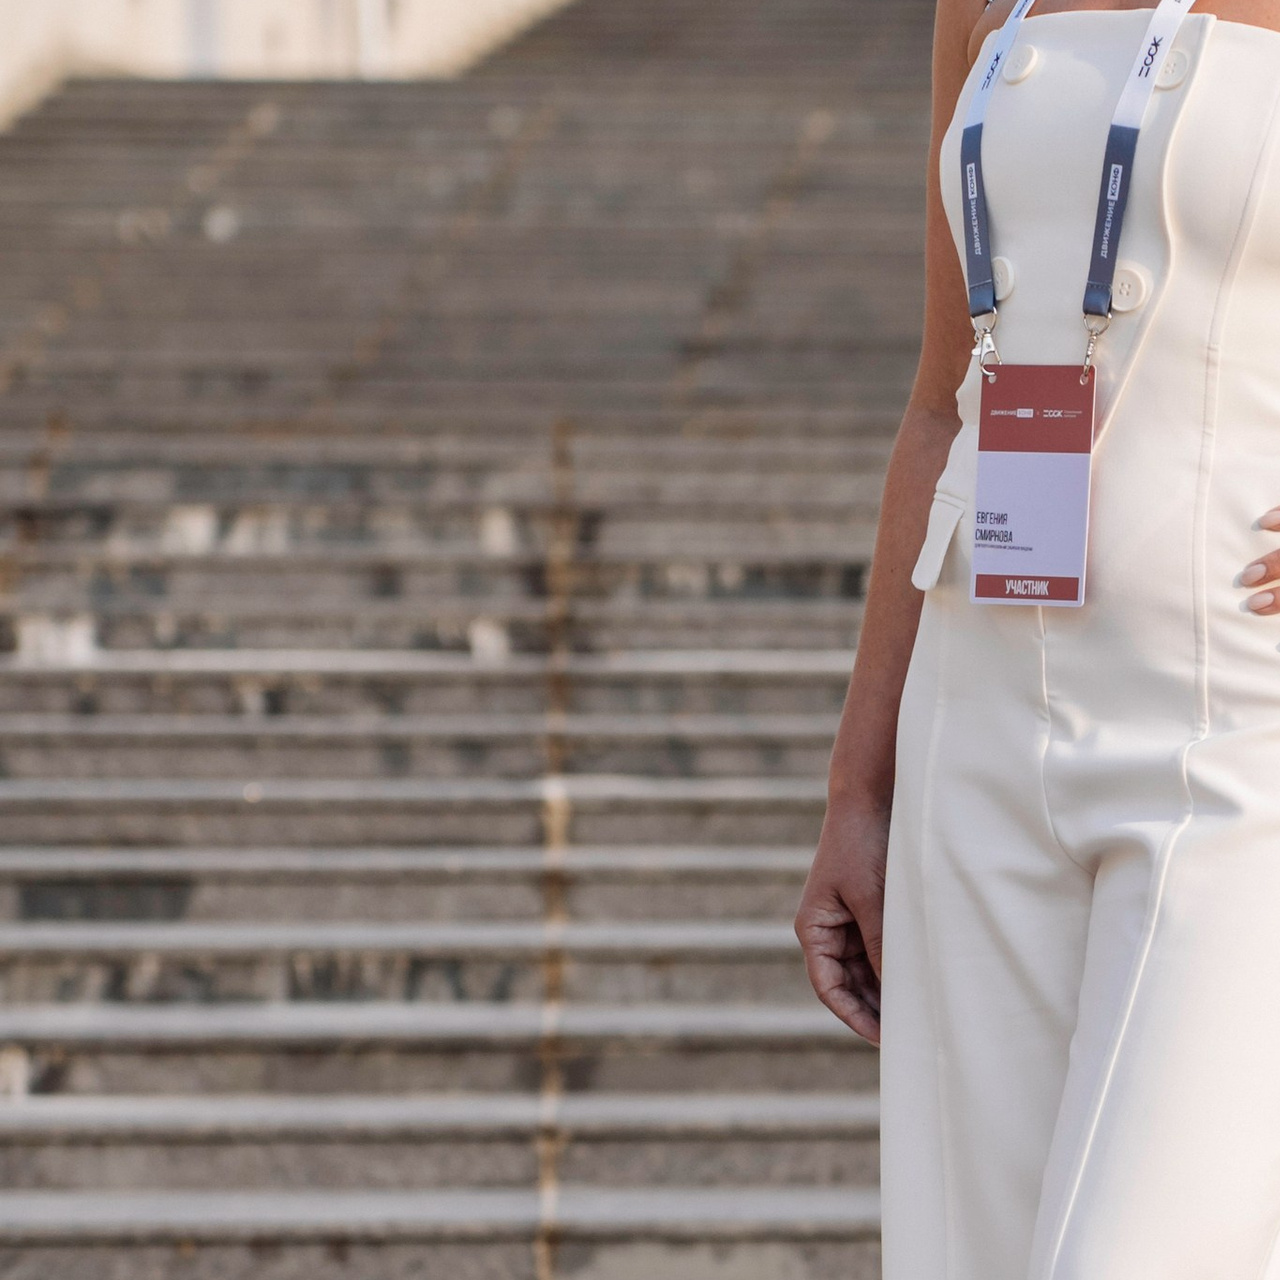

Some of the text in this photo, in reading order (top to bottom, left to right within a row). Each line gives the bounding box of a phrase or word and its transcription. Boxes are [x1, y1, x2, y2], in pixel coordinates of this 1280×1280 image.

[968, 165, 982, 255] ДВИЖЕНИЕ КОНФ
[1100, 166, 1120, 259] ДВИЖЕНИЕ КОНФ
[976, 511, 1008, 525] ЕВГЕНИЯ
[975, 528, 1013, 543] СМИРНОВА
[1005, 579, 1050, 596] УЧАСТНИК
